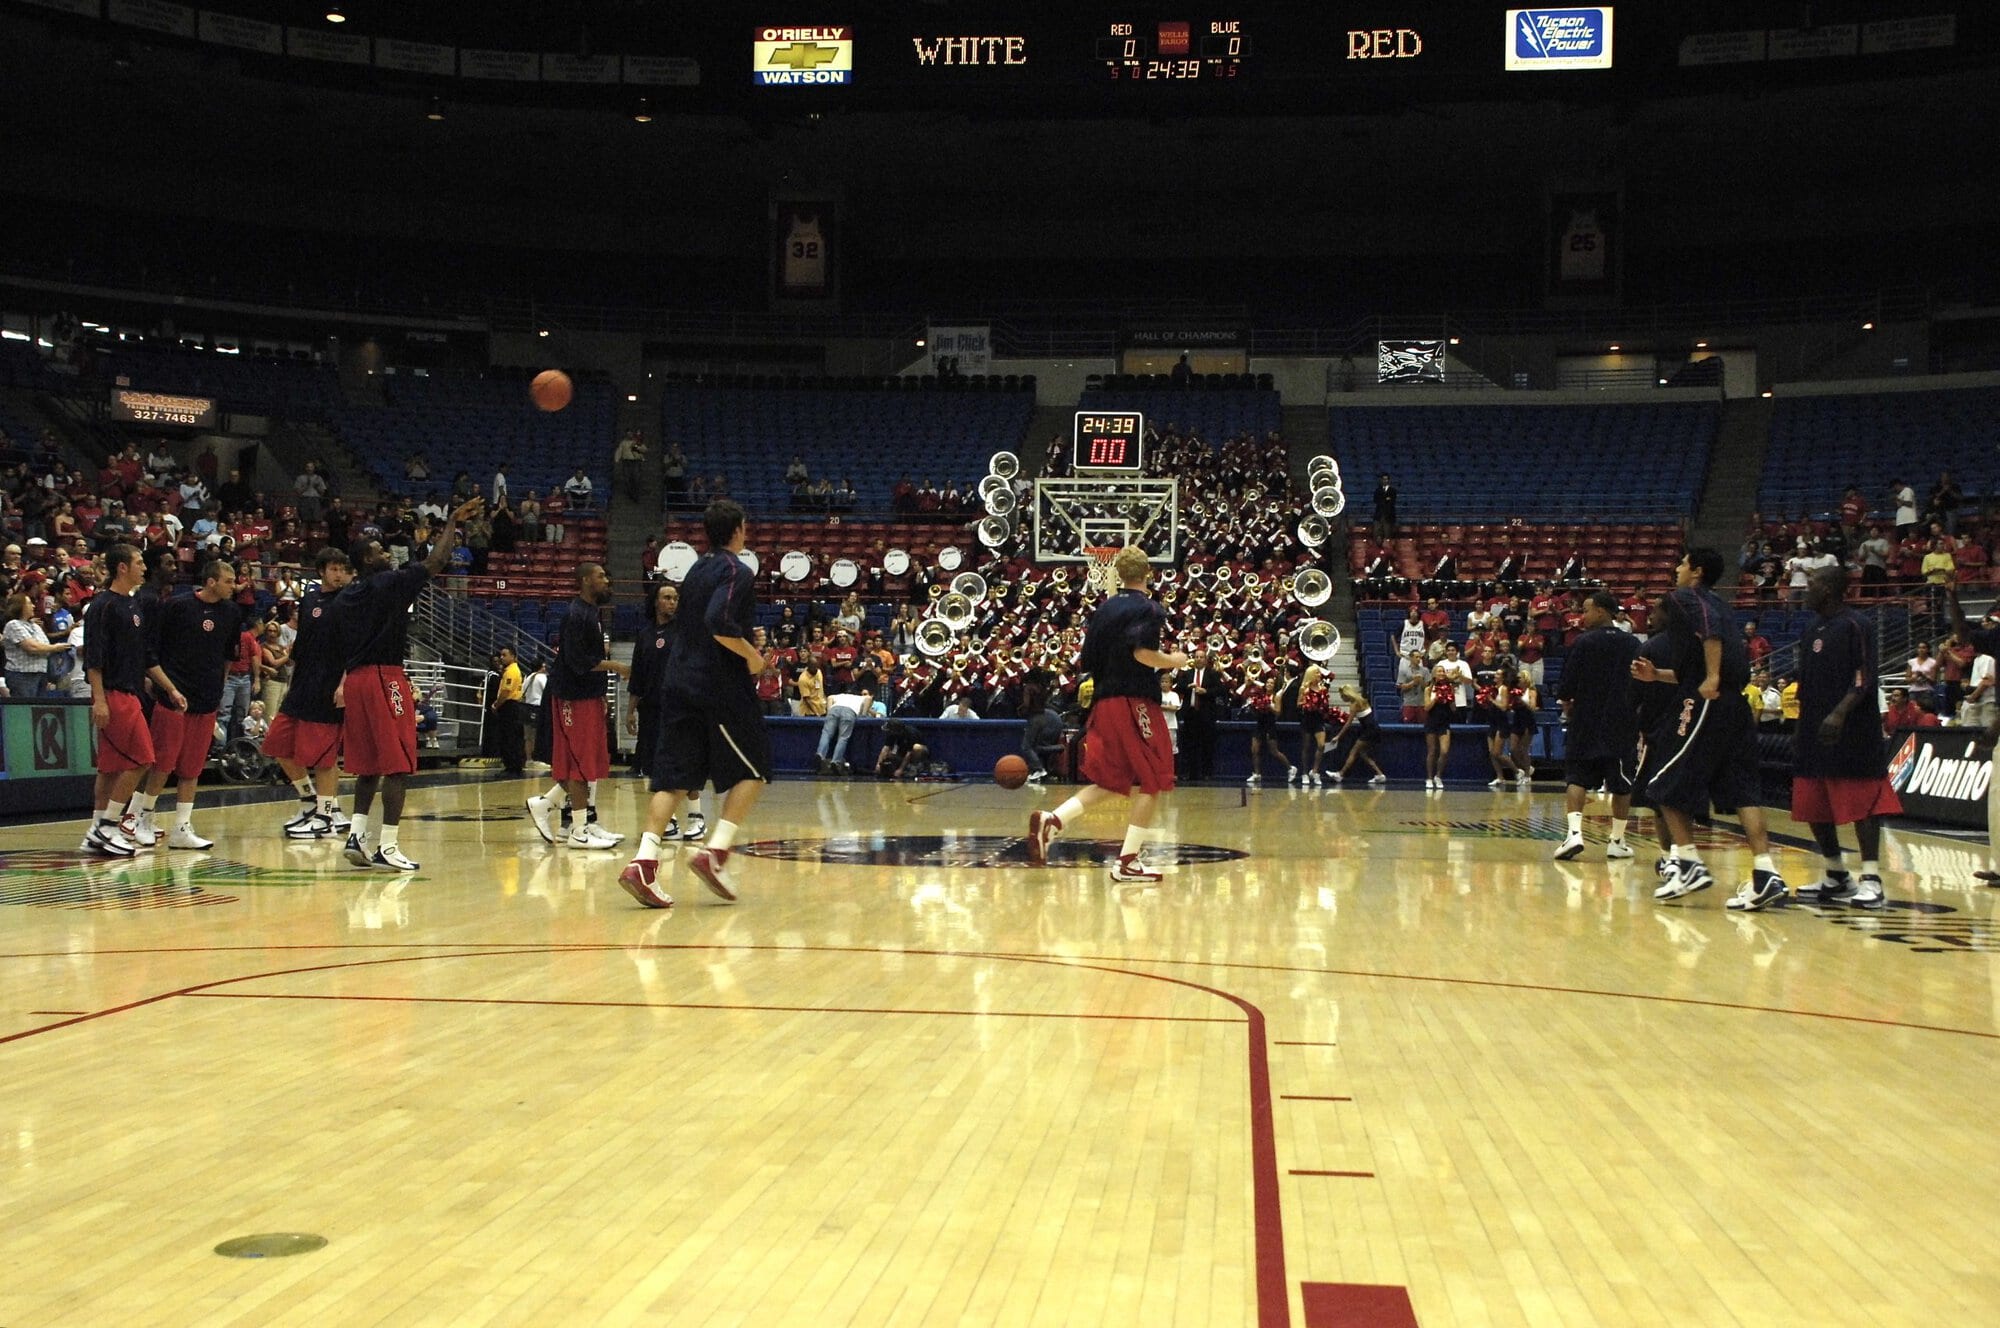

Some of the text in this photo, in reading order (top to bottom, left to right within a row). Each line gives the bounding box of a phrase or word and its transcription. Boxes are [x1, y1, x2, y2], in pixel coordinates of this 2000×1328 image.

[1211, 21, 1240, 34] BLUE
[1536, 15, 1585, 28] Tucson
[762, 28, 844, 41] O'RIELLY
[1110, 24, 1133, 36] RED
[1541, 25, 1595, 39] Electric
[1124, 40, 1136, 57] 0
[1160, 38, 1189, 46] FARGO
[1228, 37, 1240, 55] 0
[1346, 28, 1422, 59] RED
[1546, 38, 1595, 51] Power
[913, 37, 1026, 65] WHITE
[1146, 60, 1200, 79] 24:39
[762, 71, 844, 84] WATSON
[1570, 233, 1596, 252] 25
[792, 241, 818, 259] 32
[1134, 331, 1238, 340] HALL OF CHAMPIONS
[134, 410, 196, 424] 327-7463
[1083, 417, 1135, 434] 24:39
[1090, 438, 1126, 463] 00
[829, 516, 840, 525] 20
[1511, 518, 1522, 527] 22
[496, 580, 506, 590] 19
[389, 680, 405, 716] CATS
[562, 701, 573, 727] ATS
[1135, 703, 1153, 739] CATS
